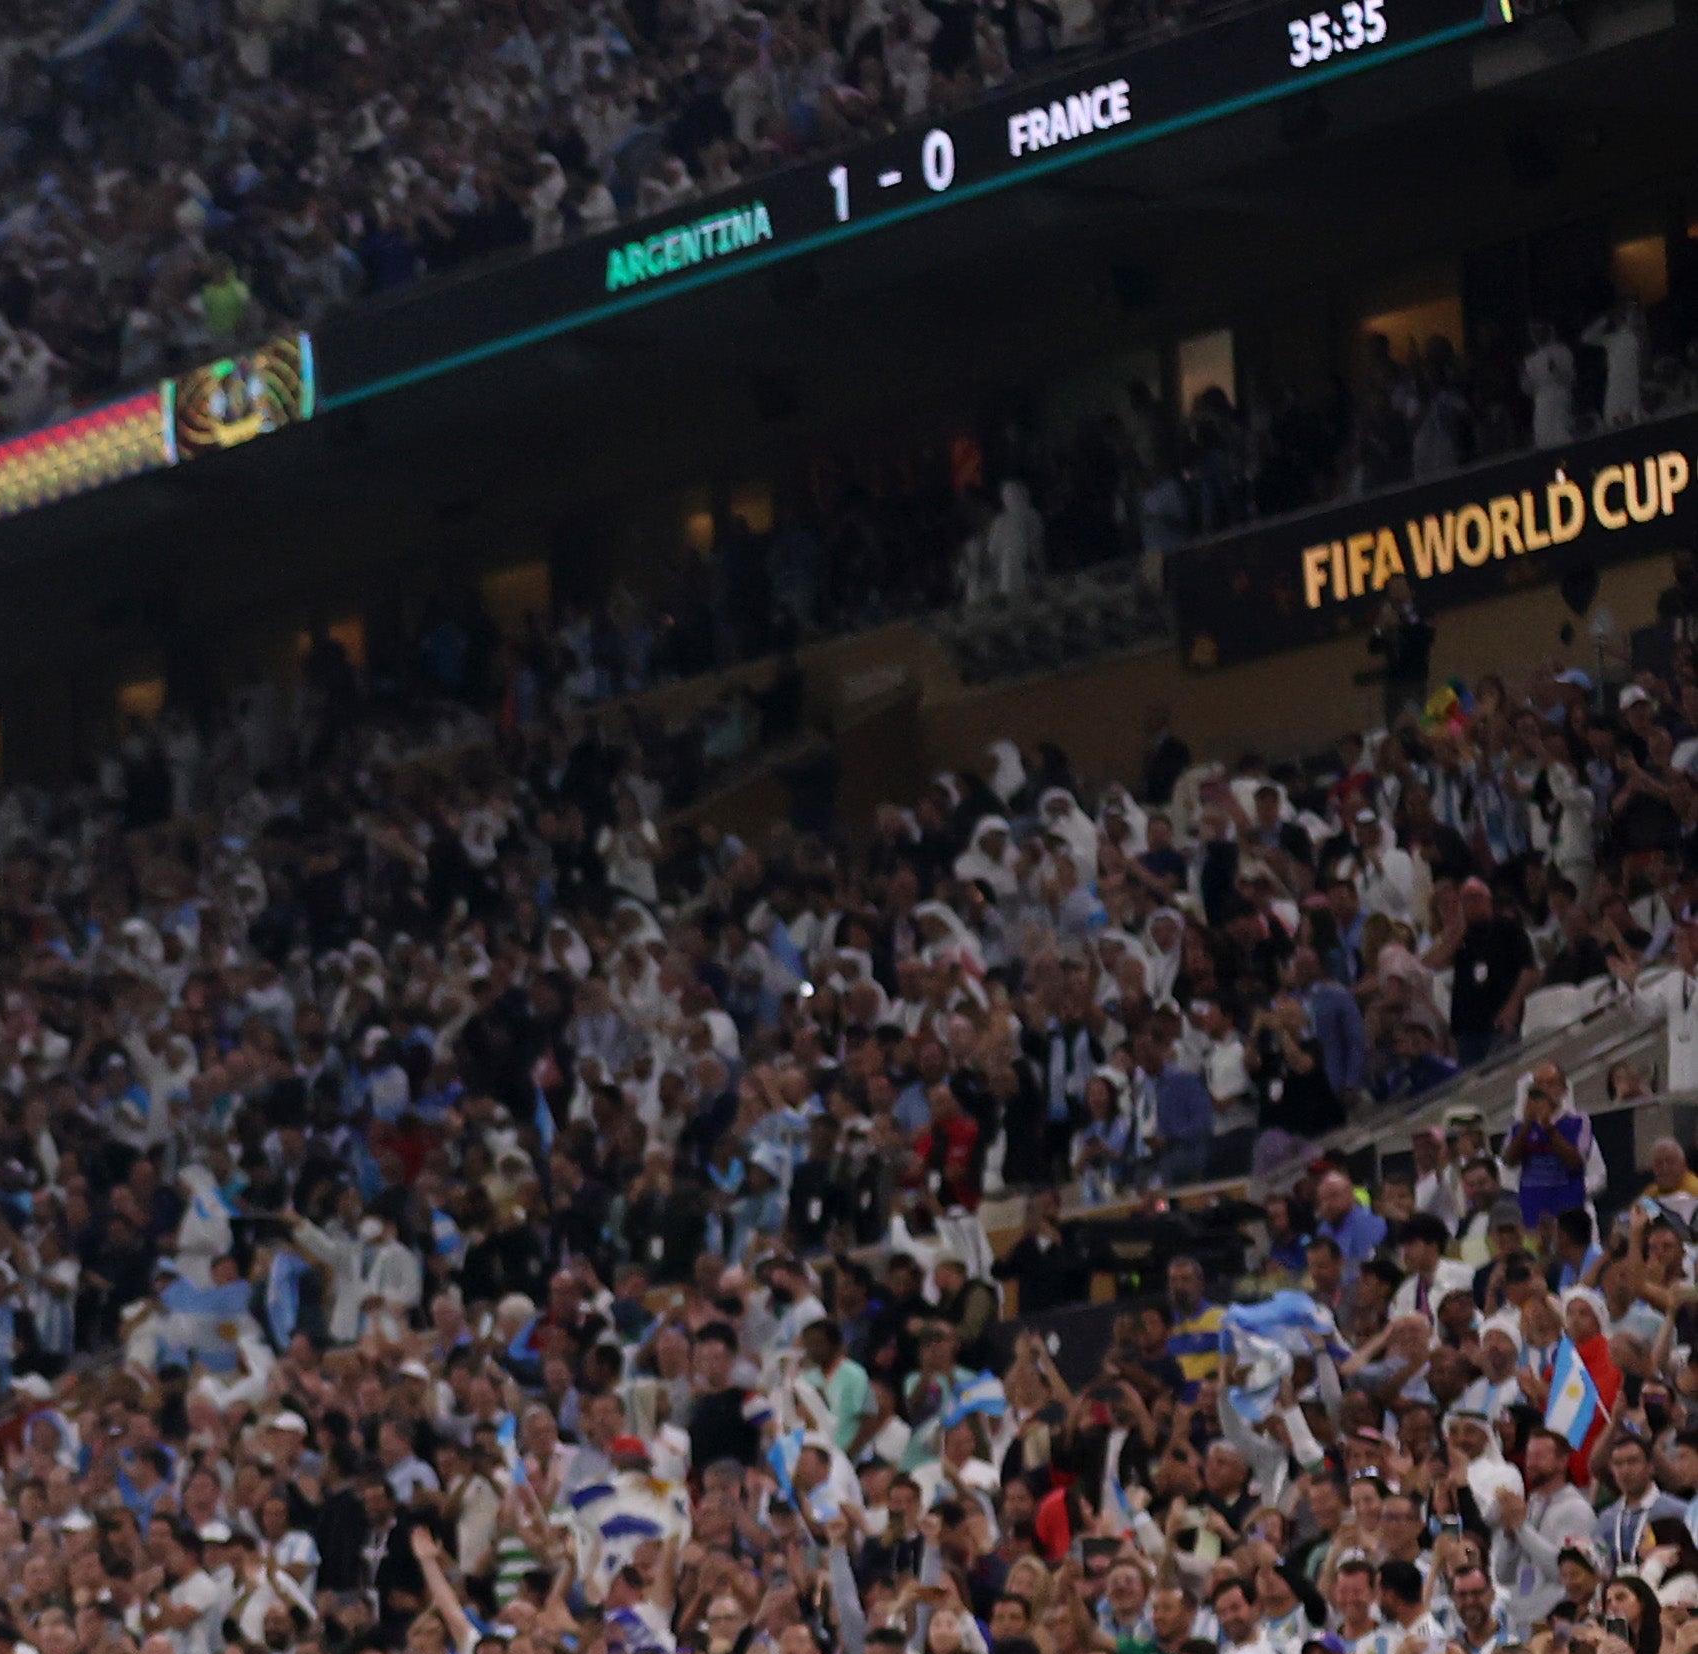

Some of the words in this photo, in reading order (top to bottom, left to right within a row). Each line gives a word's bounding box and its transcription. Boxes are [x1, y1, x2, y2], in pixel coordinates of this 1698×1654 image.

[605, 200, 773, 292] ARGENTINA
[828, 165, 850, 222] 1
[922, 128, 955, 192] 0
[1007, 78, 1131, 157] FRANCE
[1288, 0, 1387, 68] 35:35
[1301, 527, 1405, 609] FIFA
[1407, 479, 1585, 579] WORLD
[1592, 450, 1690, 530] CUP
